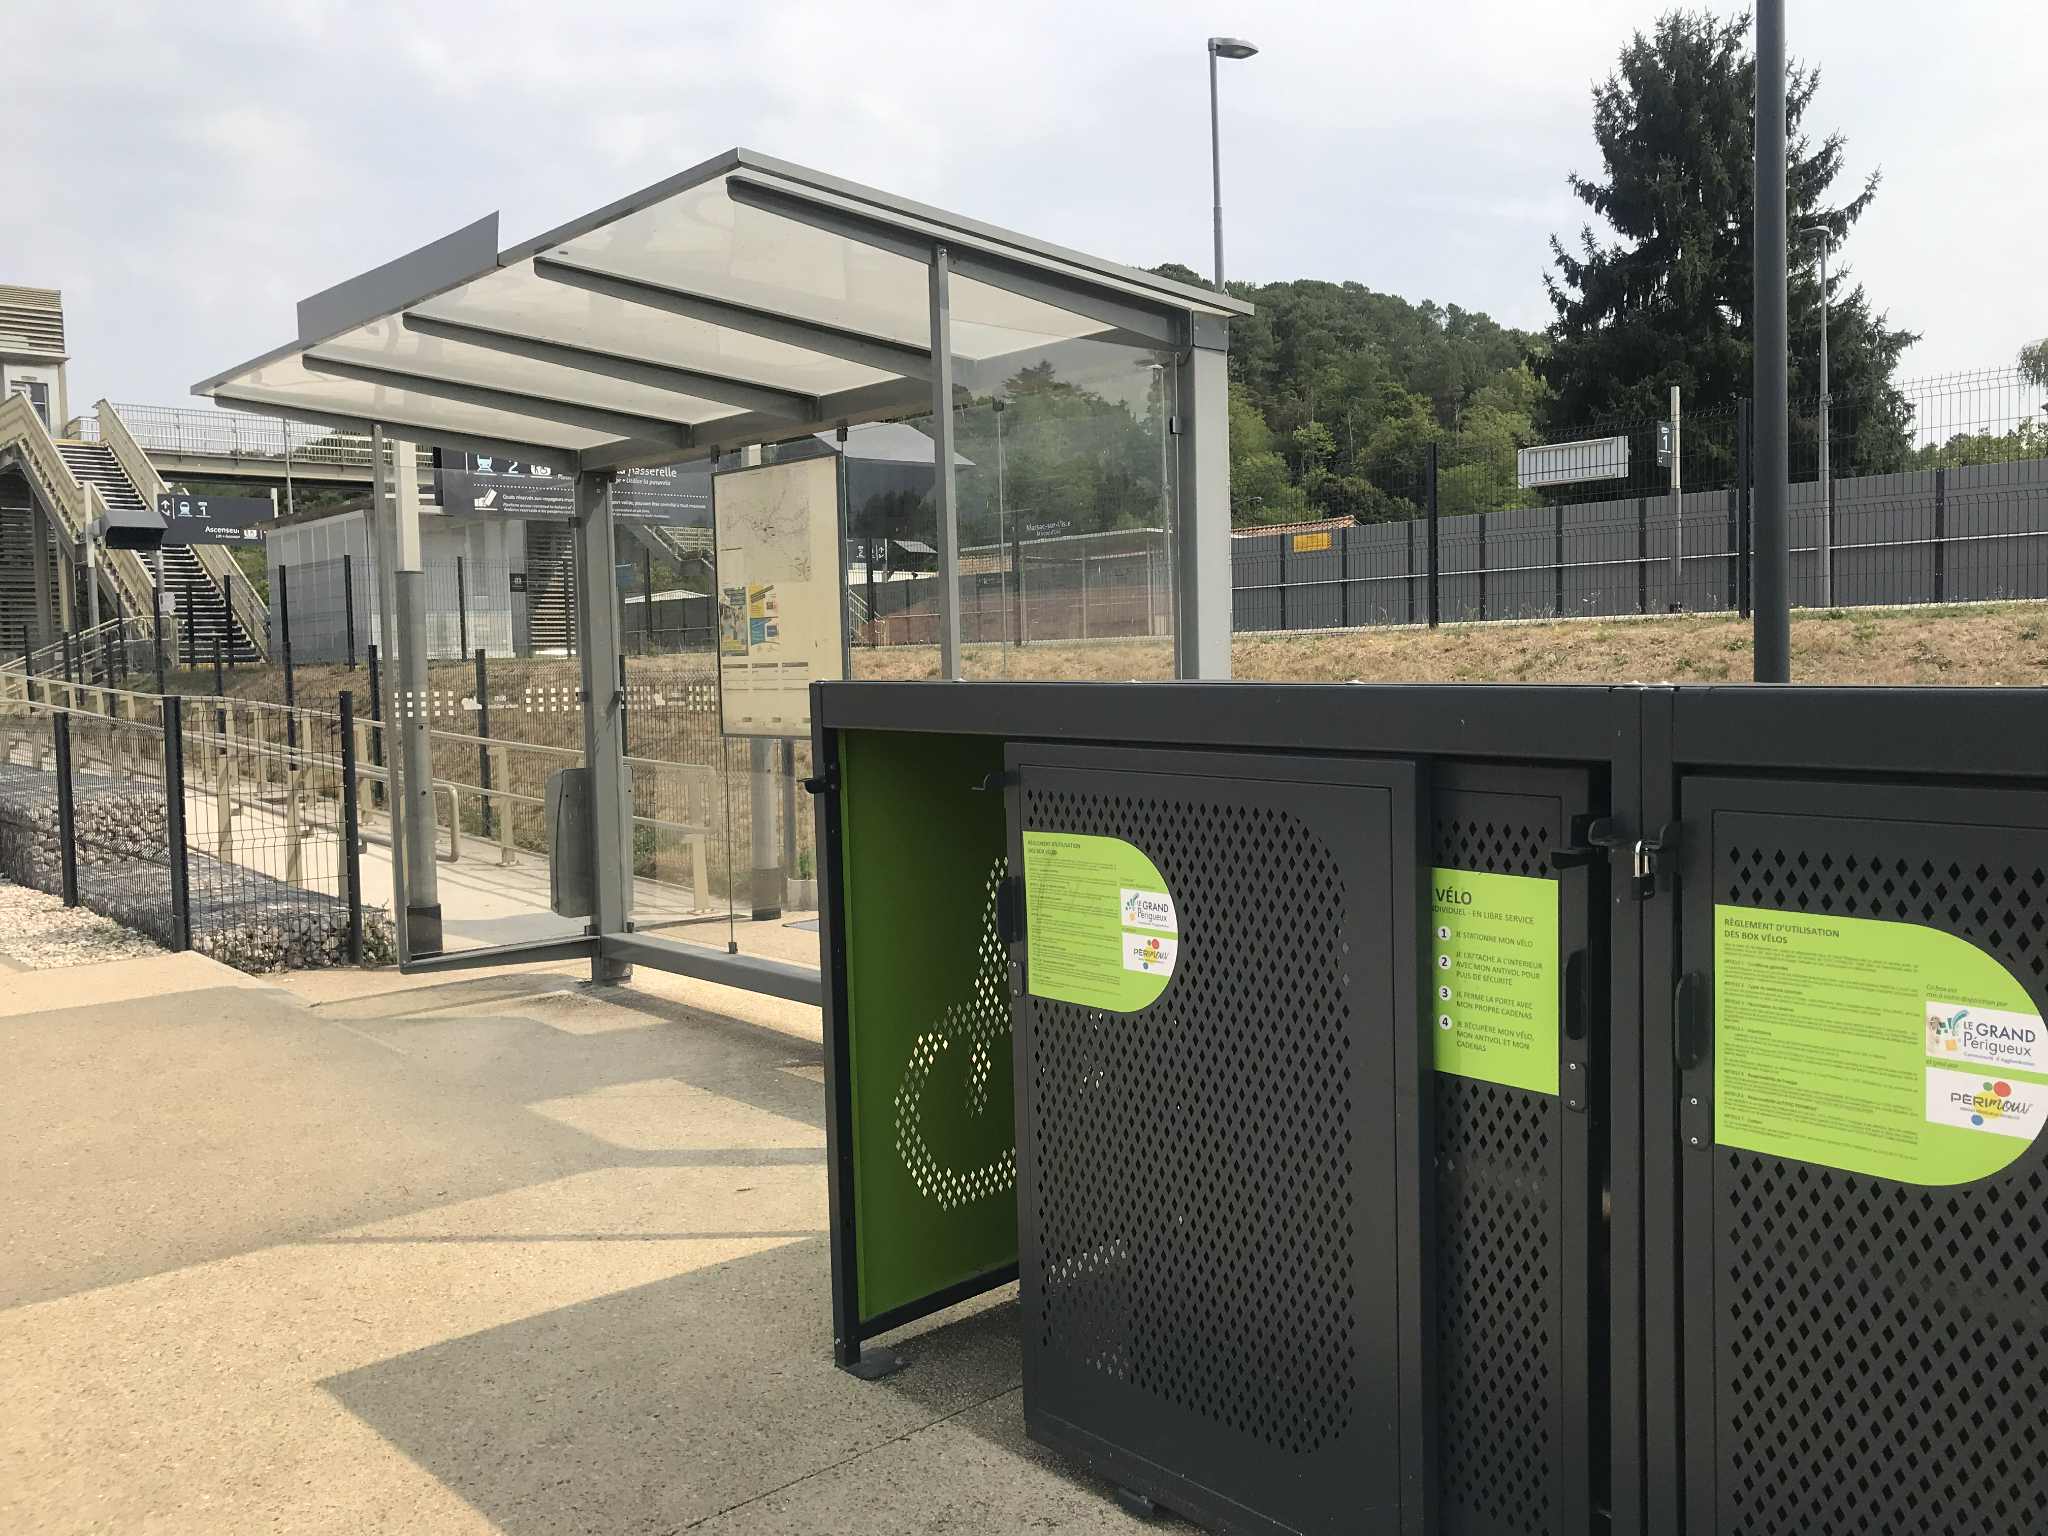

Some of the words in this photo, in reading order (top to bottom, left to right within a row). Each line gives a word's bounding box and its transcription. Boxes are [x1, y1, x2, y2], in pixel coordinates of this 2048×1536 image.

[1435, 886, 1472, 905] VÉLO
[1142, 901, 1169, 913] GRAND
[1432, 904, 1466, 916] NDIVIDUEL
[1472, 909, 1482, 918] EN
[1484, 911, 1504, 921] LIBRE
[1505, 914, 1535, 925] SERVICE
[1724, 917, 1774, 930] RÈGLEMENT
[1776, 923, 1840, 938] D'UTILISATION
[1724, 930, 1740, 939] DES
[1741, 931, 1759, 941] BOX
[1761, 933, 1788, 944] VÉLOS
[1963, 1021, 1973, 1030] LE
[1976, 1023, 2036, 1043] GRAND
[1963, 1031, 2032, 1057] Périgueux
